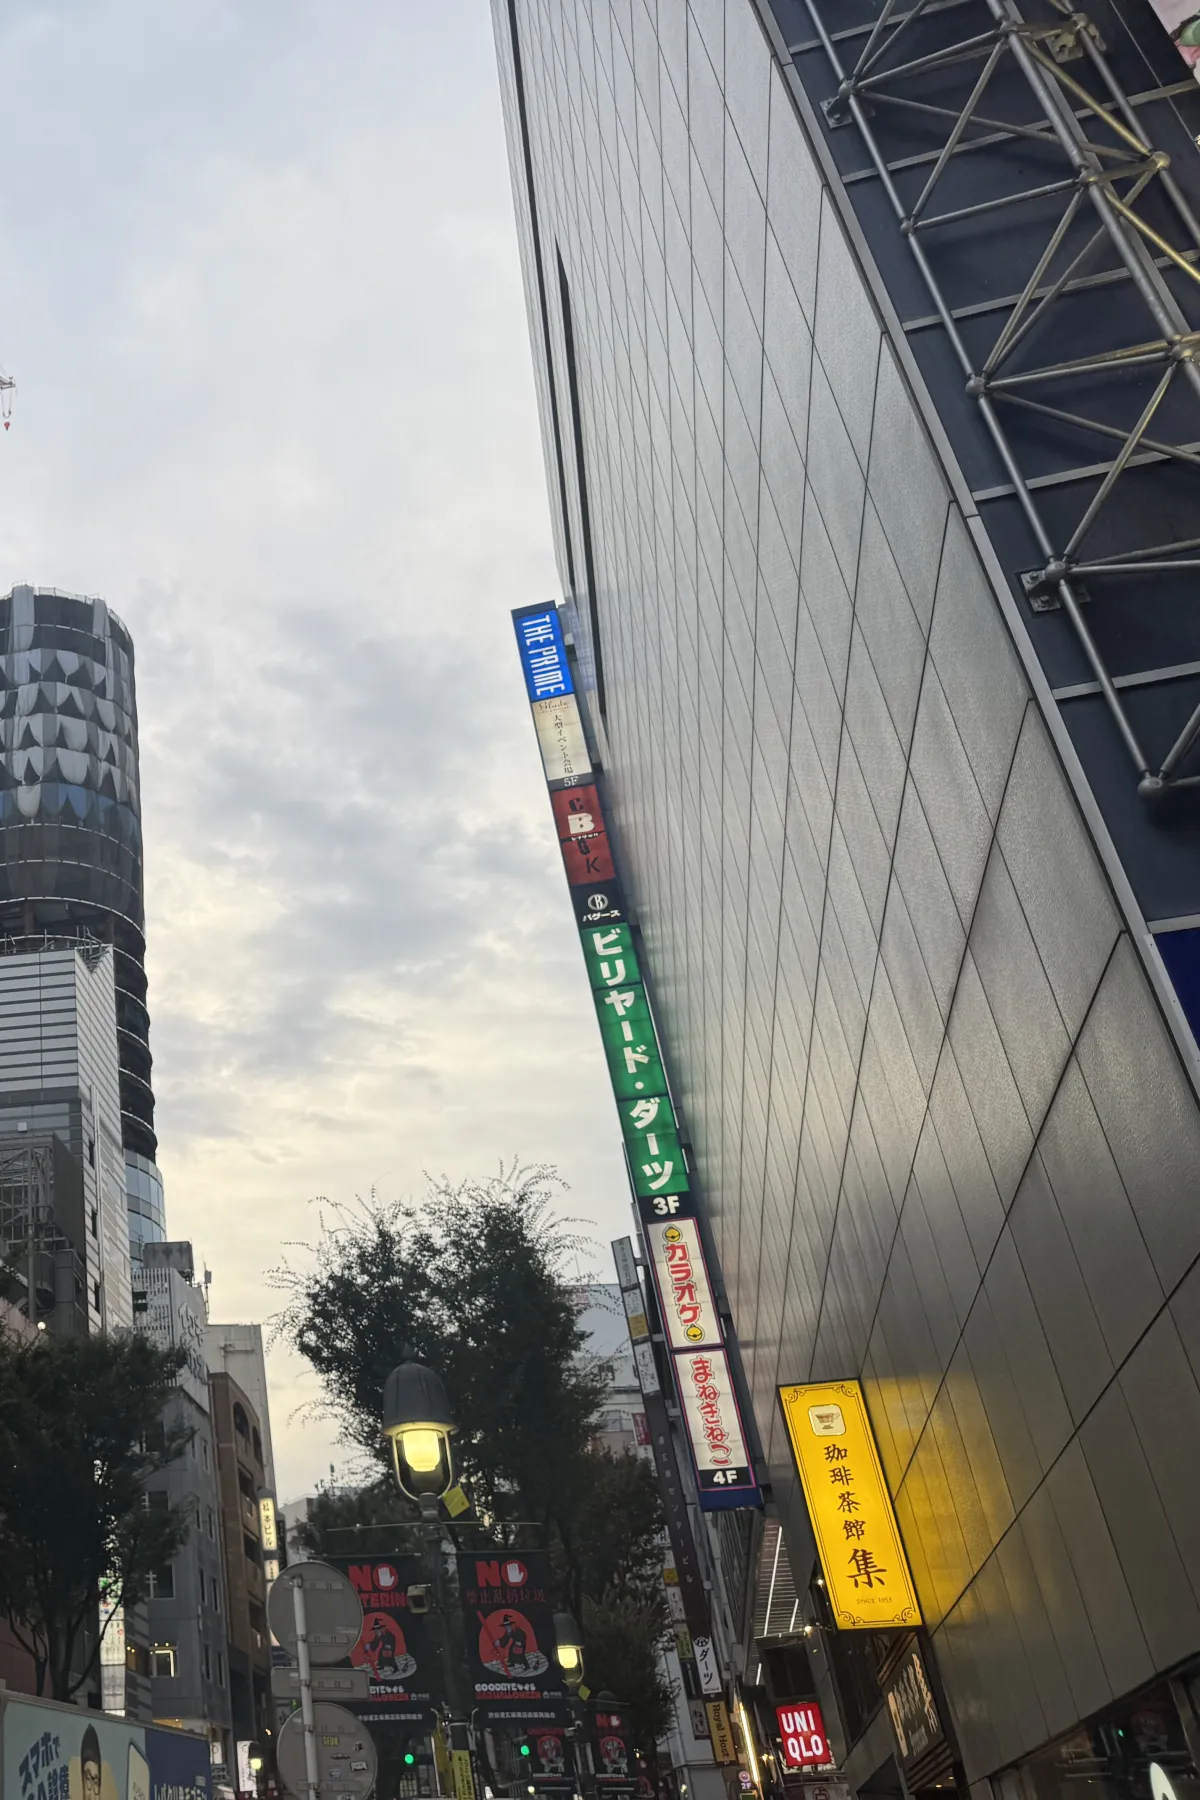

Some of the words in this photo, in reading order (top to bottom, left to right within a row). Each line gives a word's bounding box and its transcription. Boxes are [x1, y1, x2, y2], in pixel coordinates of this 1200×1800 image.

[522, 615, 554, 646] THE
[528, 646, 565, 696] PRIME
[564, 776, 579, 787] 5F
[653, 1196, 680, 1215] 3F
[665, 1243, 700, 1324] カラオケ
[692, 1357, 730, 1465] まねきねこ
[713, 1470, 738, 1485] 4F
[699, 1648, 714, 1685] ダーツ
[712, 1703, 722, 1736] Royal
[718, 1737, 731, 1758] Host
[781, 1710, 815, 1733] UNI
[787, 1735, 823, 1761] QLO
